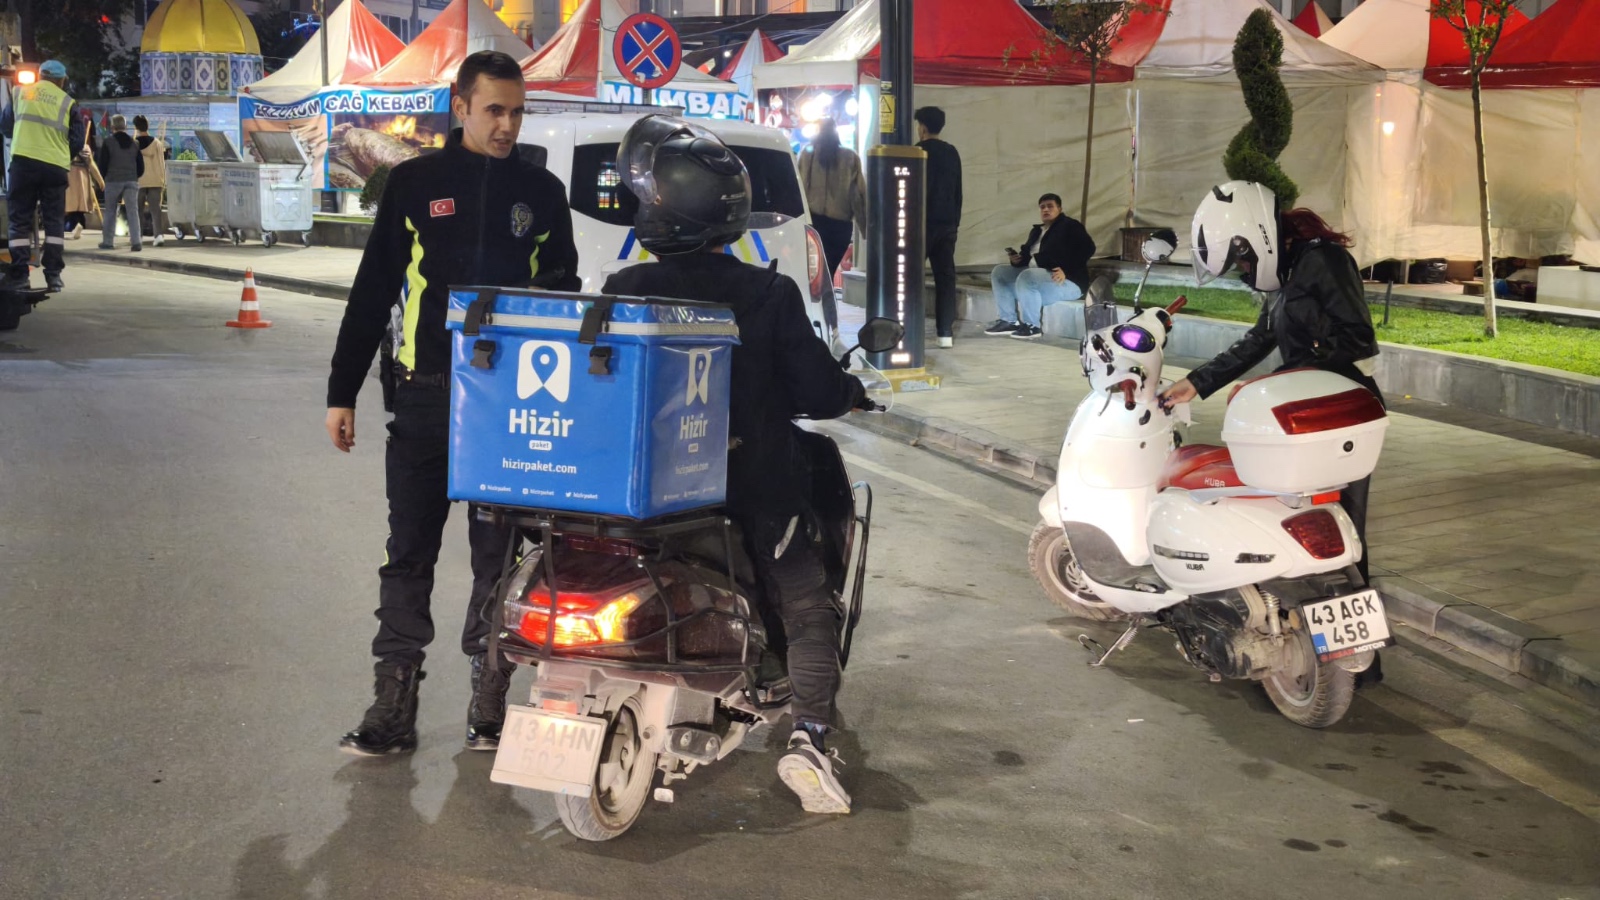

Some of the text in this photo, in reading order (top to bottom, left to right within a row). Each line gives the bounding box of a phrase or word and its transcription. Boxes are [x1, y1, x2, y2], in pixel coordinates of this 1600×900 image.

[254, 100, 321, 118] ERZURUM
[368, 95, 433, 111] KEBABI
[509, 408, 574, 437] Hizir
[680, 413, 708, 440] Hizir
[531, 441, 549, 449] paket
[502, 457, 577, 474] hizirpaket.com
[1204, 477, 1225, 488] KUBA
[1311, 594, 1378, 626] 43 AGK
[1333, 621, 1370, 645] 458
[1317, 646, 1328, 654] TR
[511, 717, 596, 752] 43 AHN
